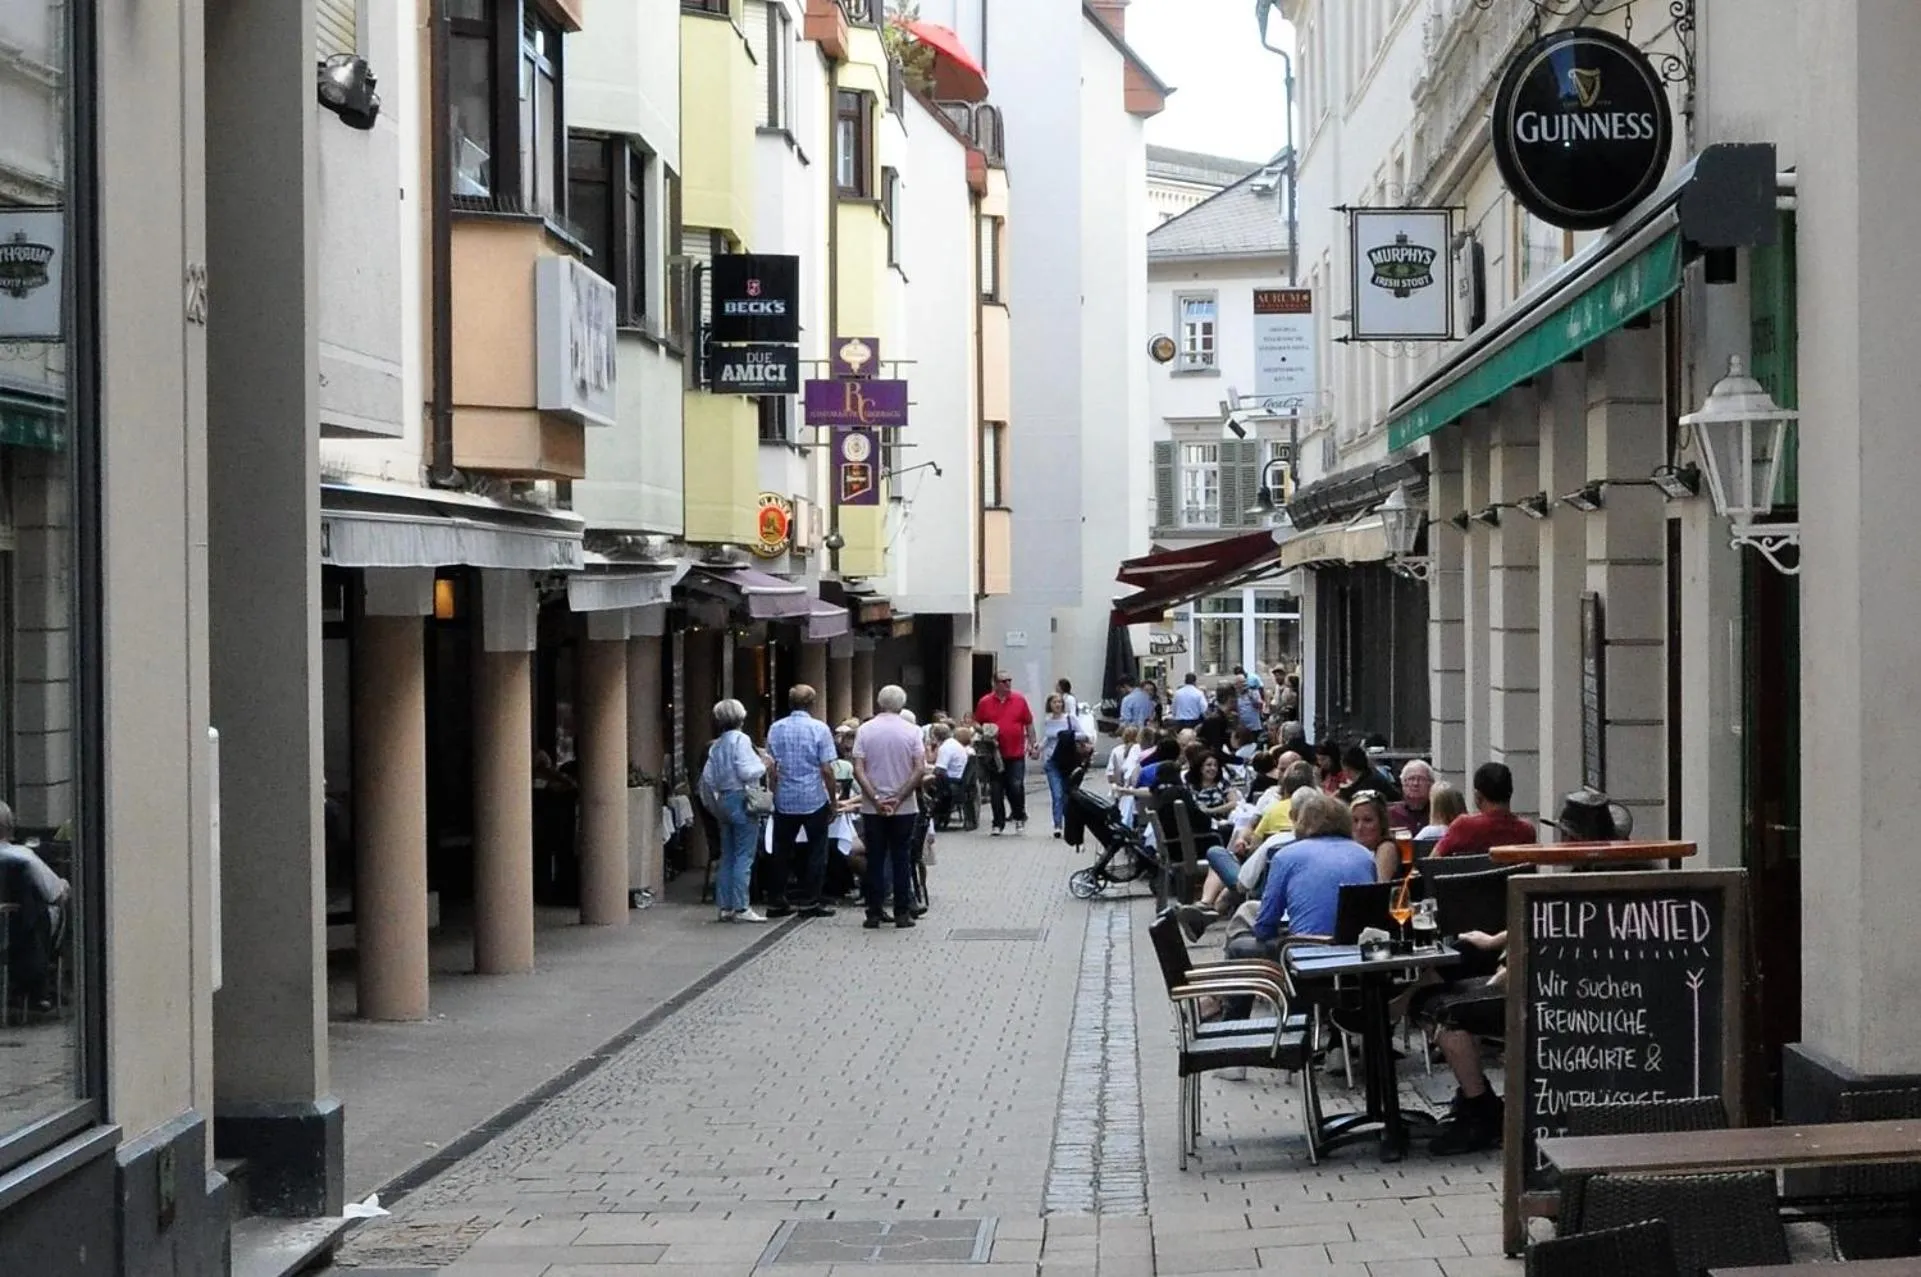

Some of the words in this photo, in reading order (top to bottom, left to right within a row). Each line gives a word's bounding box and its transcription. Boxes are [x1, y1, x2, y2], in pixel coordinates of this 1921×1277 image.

[1516, 111, 1653, 143] GUINNESS
[724, 300, 786, 314] BECK'S
[721, 364, 787, 381] AMICI
[746, 352, 773, 364] DUE
[1533, 901, 1597, 939] HELP
[1607, 899, 1711, 943] WANTED
[1537, 969, 1569, 997] Wir
[1576, 973, 1643, 999] suchen
[1537, 1036, 1637, 1073] ENGAGIRTE
[1644, 1043, 1663, 1072] &
